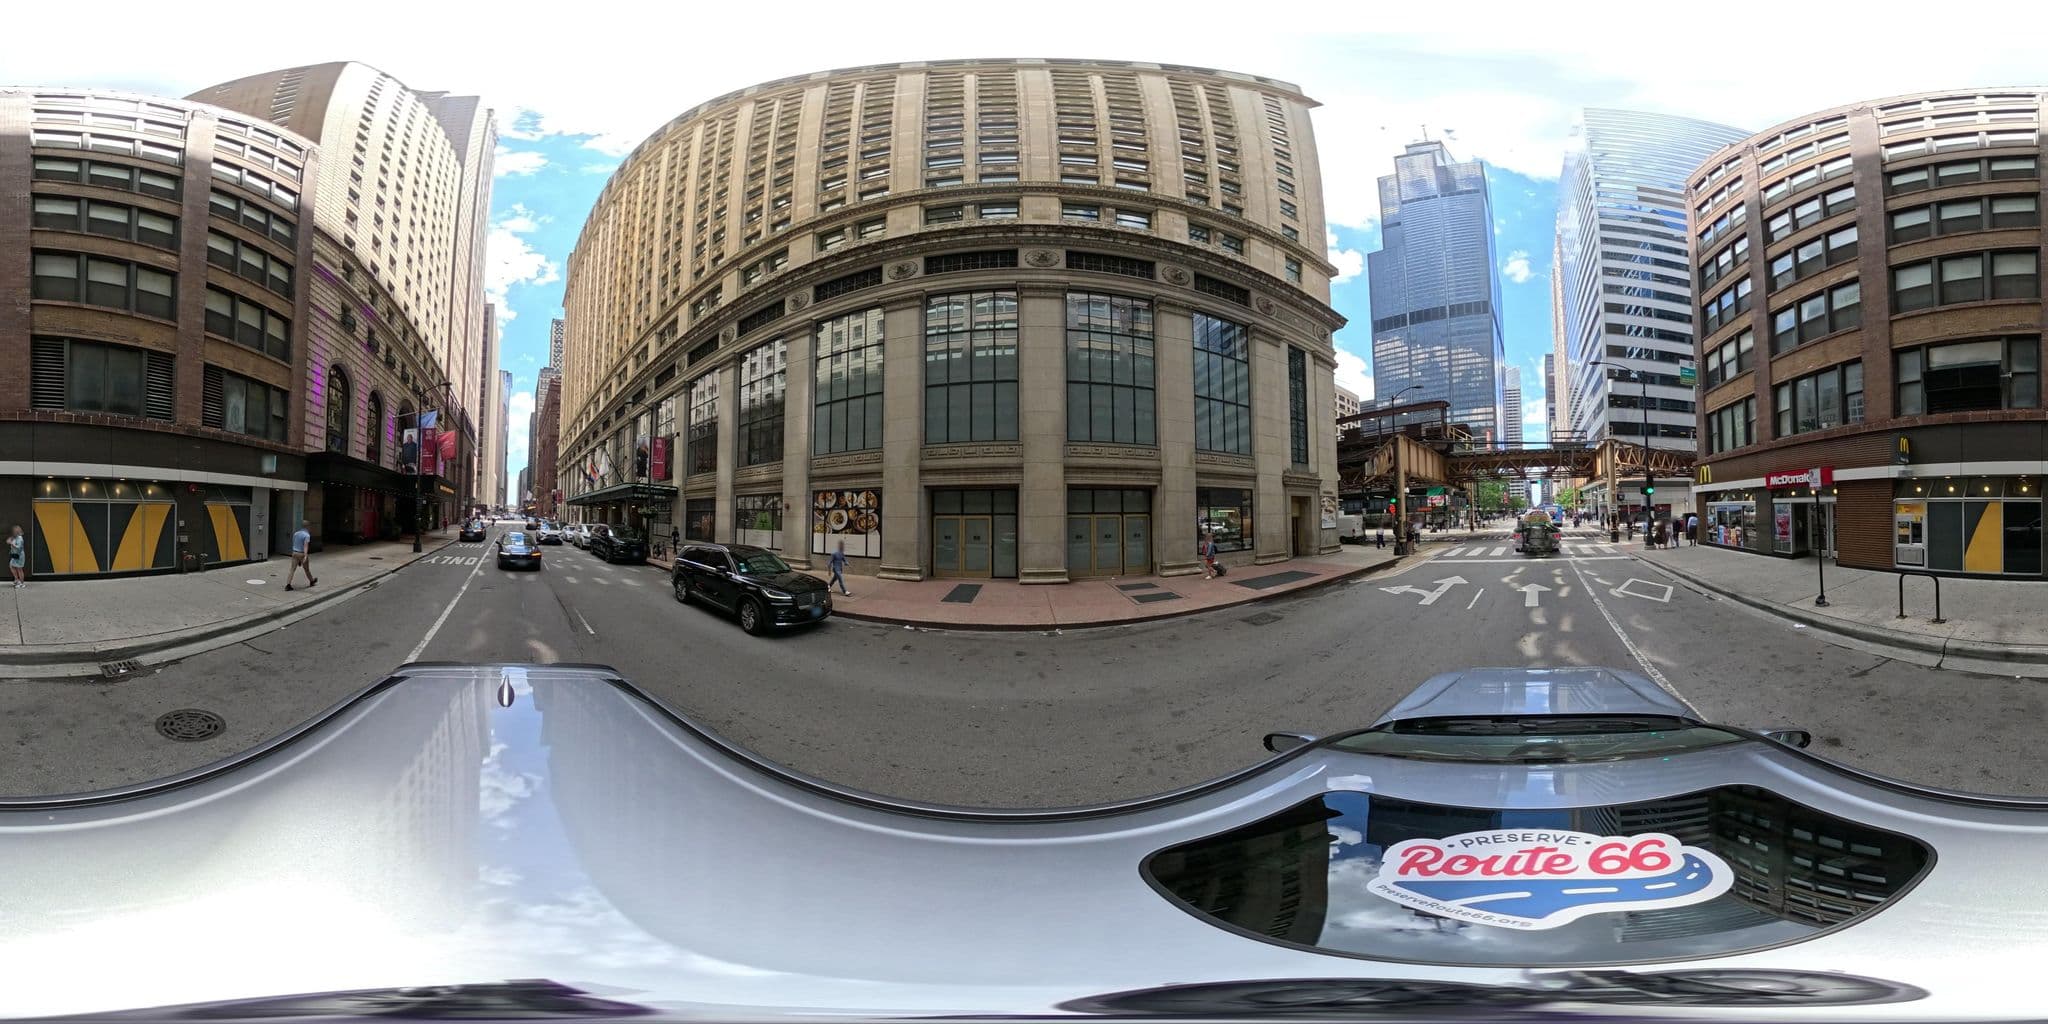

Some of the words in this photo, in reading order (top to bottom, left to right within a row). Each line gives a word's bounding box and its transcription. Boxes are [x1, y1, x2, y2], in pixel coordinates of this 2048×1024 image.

[1770, 473, 1811, 485] McDonal
[421, 556, 478, 565] ONLY
[1460, 833, 1580, 848] PRESERVE
[1397, 845, 1579, 876] Route
[1588, 839, 1671, 875] 66
[1376, 884, 1533, 927] PreserveRoute66.org
